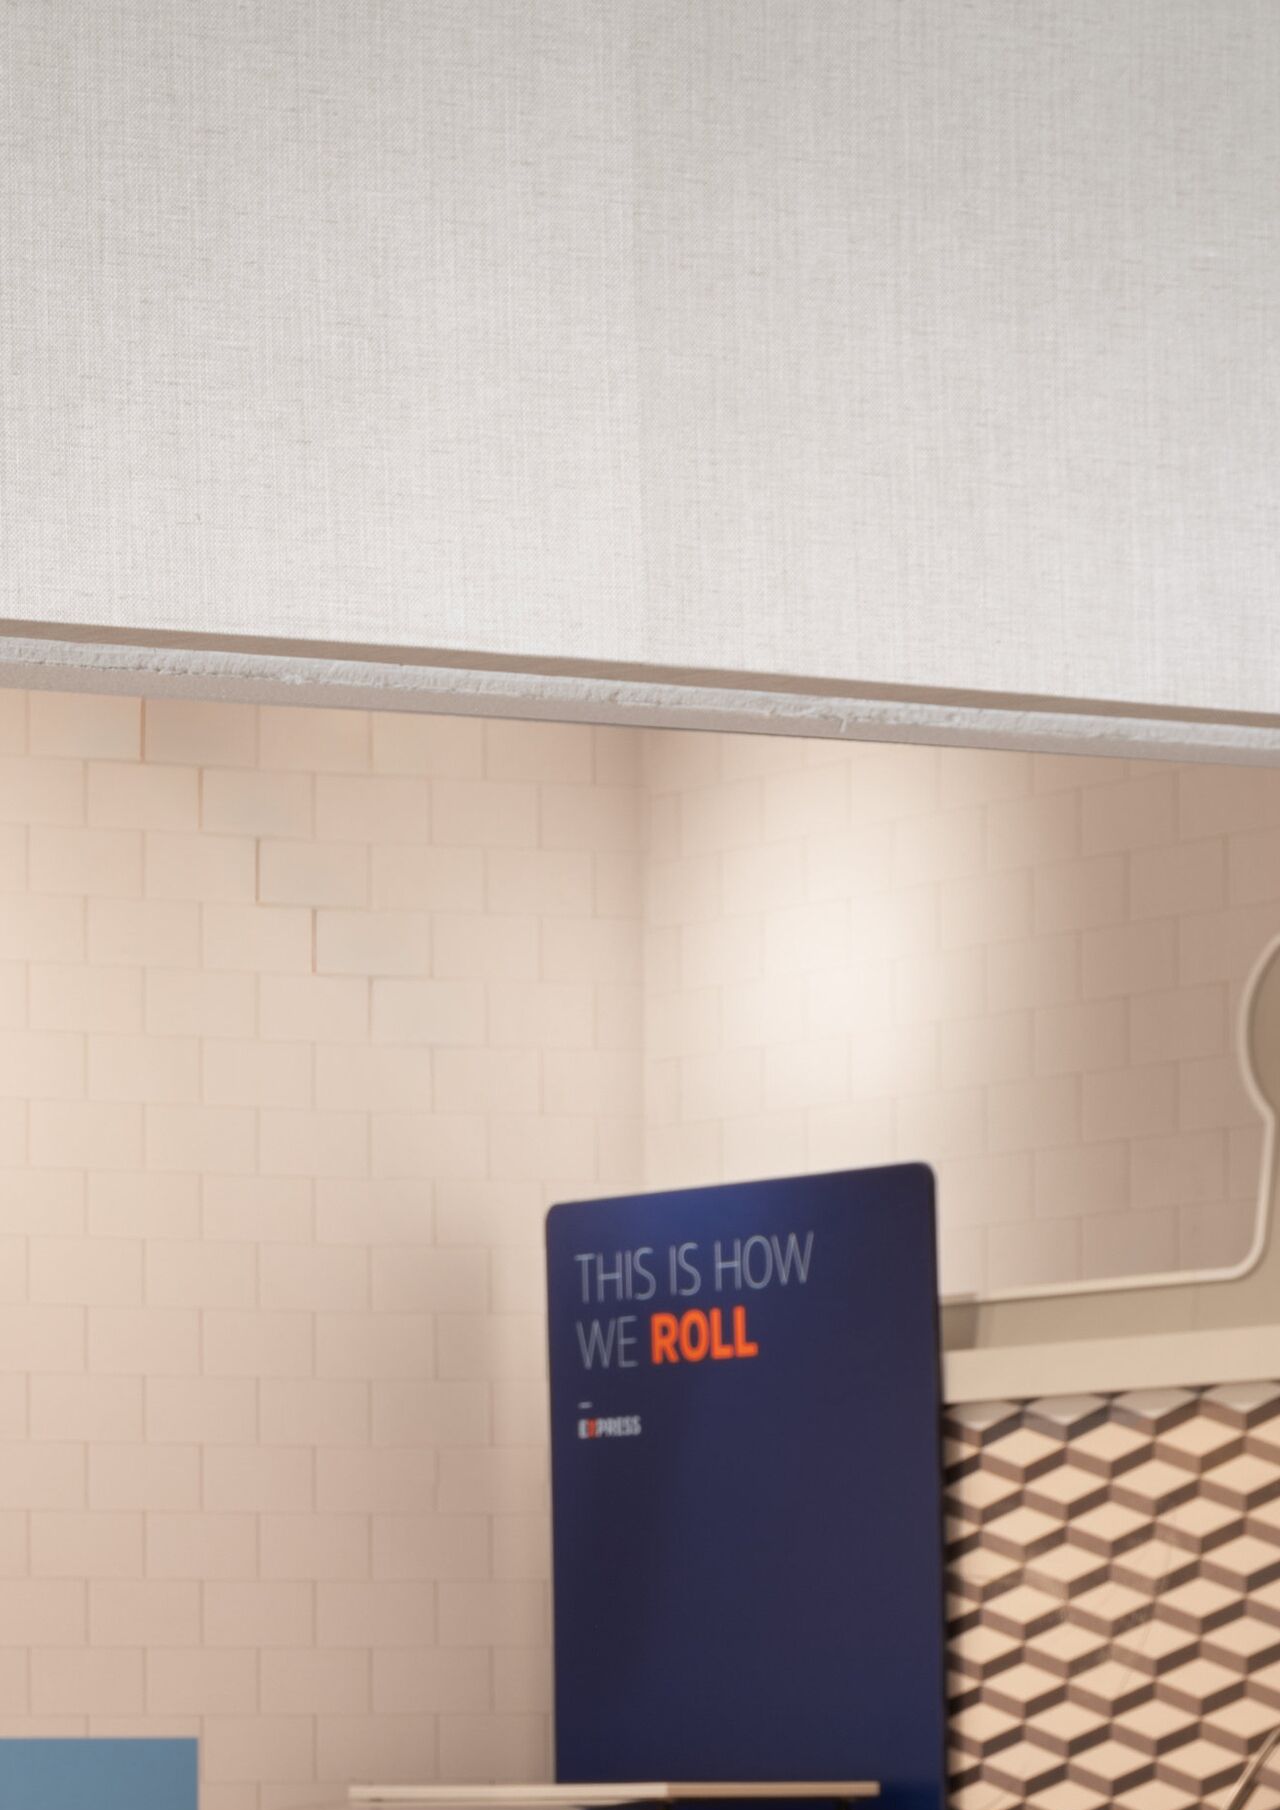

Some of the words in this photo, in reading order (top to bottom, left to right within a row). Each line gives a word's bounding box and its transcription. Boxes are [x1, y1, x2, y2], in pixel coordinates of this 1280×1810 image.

[574, 1247, 657, 1303] THIS
[669, 1242, 702, 1296] IS
[715, 1230, 814, 1292] HOW
[576, 1315, 638, 1370] WE
[650, 1305, 758, 1365] ROLL
[578, 1415, 641, 1438] EXPRESS
